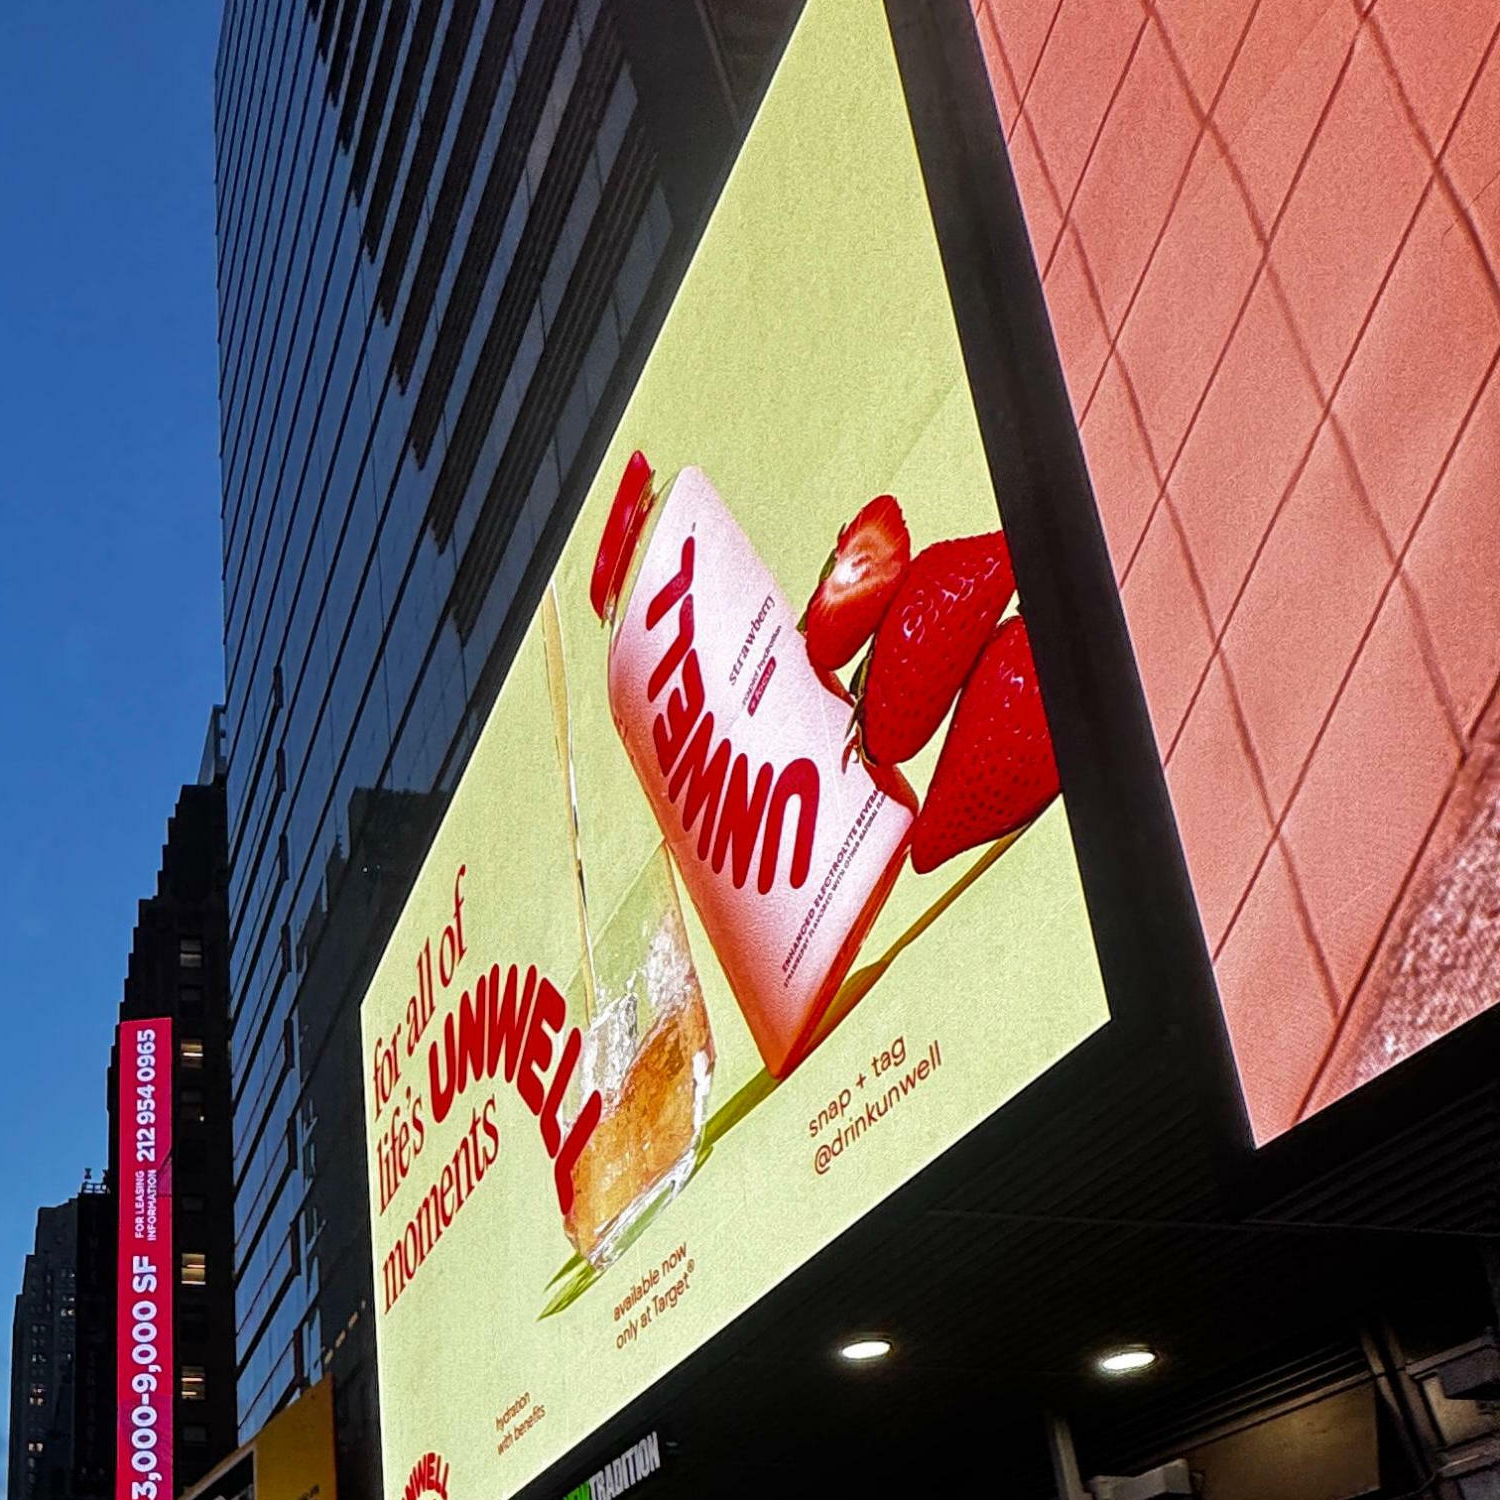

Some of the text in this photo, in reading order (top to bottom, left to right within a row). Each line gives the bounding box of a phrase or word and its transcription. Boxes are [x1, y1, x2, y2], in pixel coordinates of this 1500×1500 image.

[729, 591, 776, 686] strawberry
[646, 536, 820, 895] UNWELL
[374, 864, 468, 1122] for all of
[782, 907, 815, 973] ENHANCED
[136, 1029, 156, 1163] 212 954 0965
[377, 963, 601, 1216] life's UNWELL
[809, 1035, 907, 1138] snap + tag
[814, 1039, 942, 1176] @drinkunwell
[135, 1170, 145, 1239] FOR LEASING
[146, 1169, 157, 1242] INFORMATION
[383, 1094, 499, 1315] moments
[614, 1242, 687, 1321] available now
[616, 1319, 638, 1349] only
[640, 1305, 652, 1328] at
[131, 1256, 162, 1500] 3,000-9,000 SF
